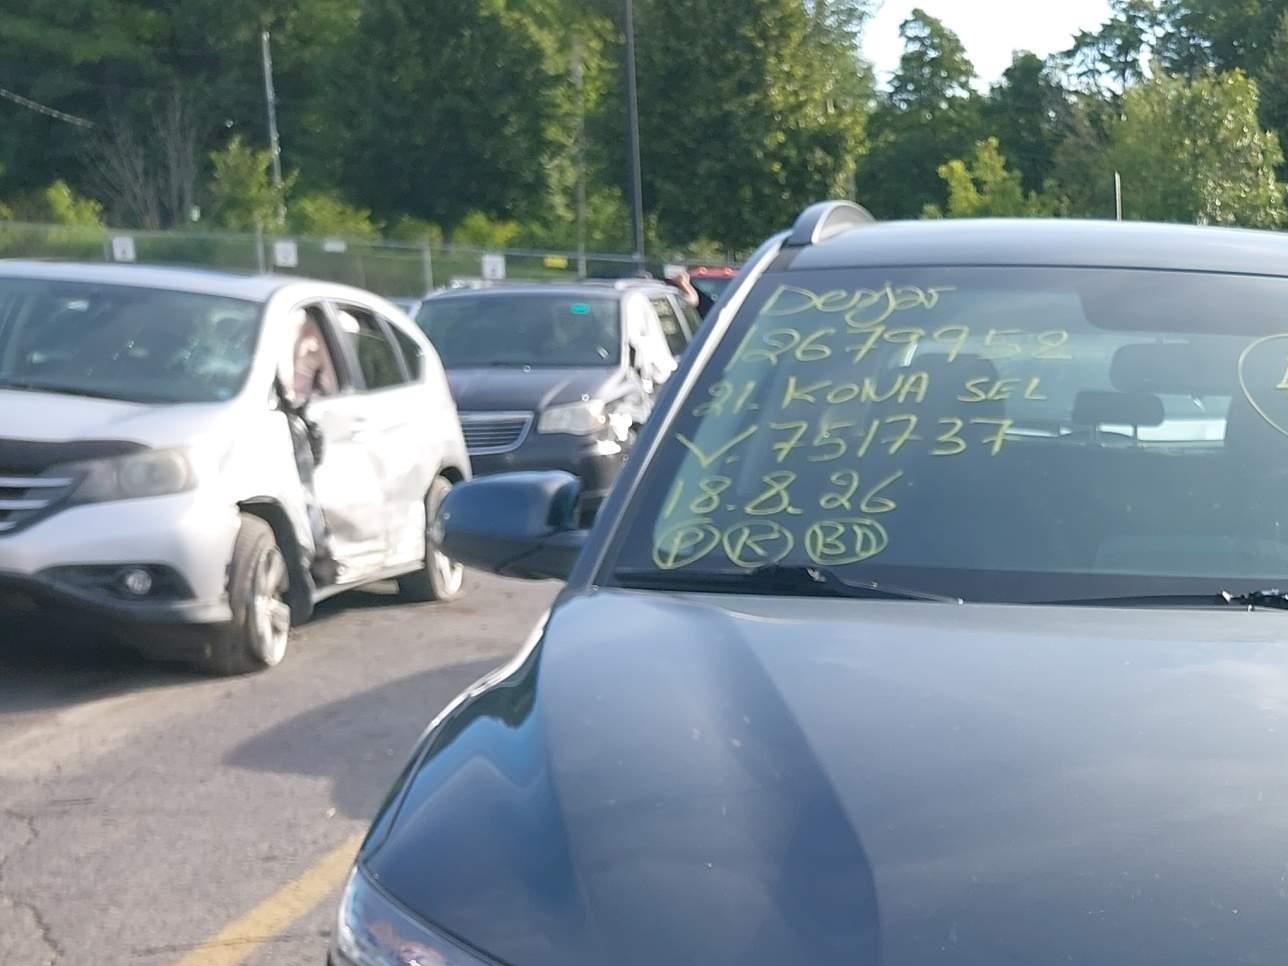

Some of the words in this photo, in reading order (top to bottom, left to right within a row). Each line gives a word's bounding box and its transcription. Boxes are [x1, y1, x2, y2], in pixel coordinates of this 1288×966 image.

[781, 371, 931, 408] KONA
[957, 376, 1050, 403] SEL
[768, 414, 1017, 464] 751737
